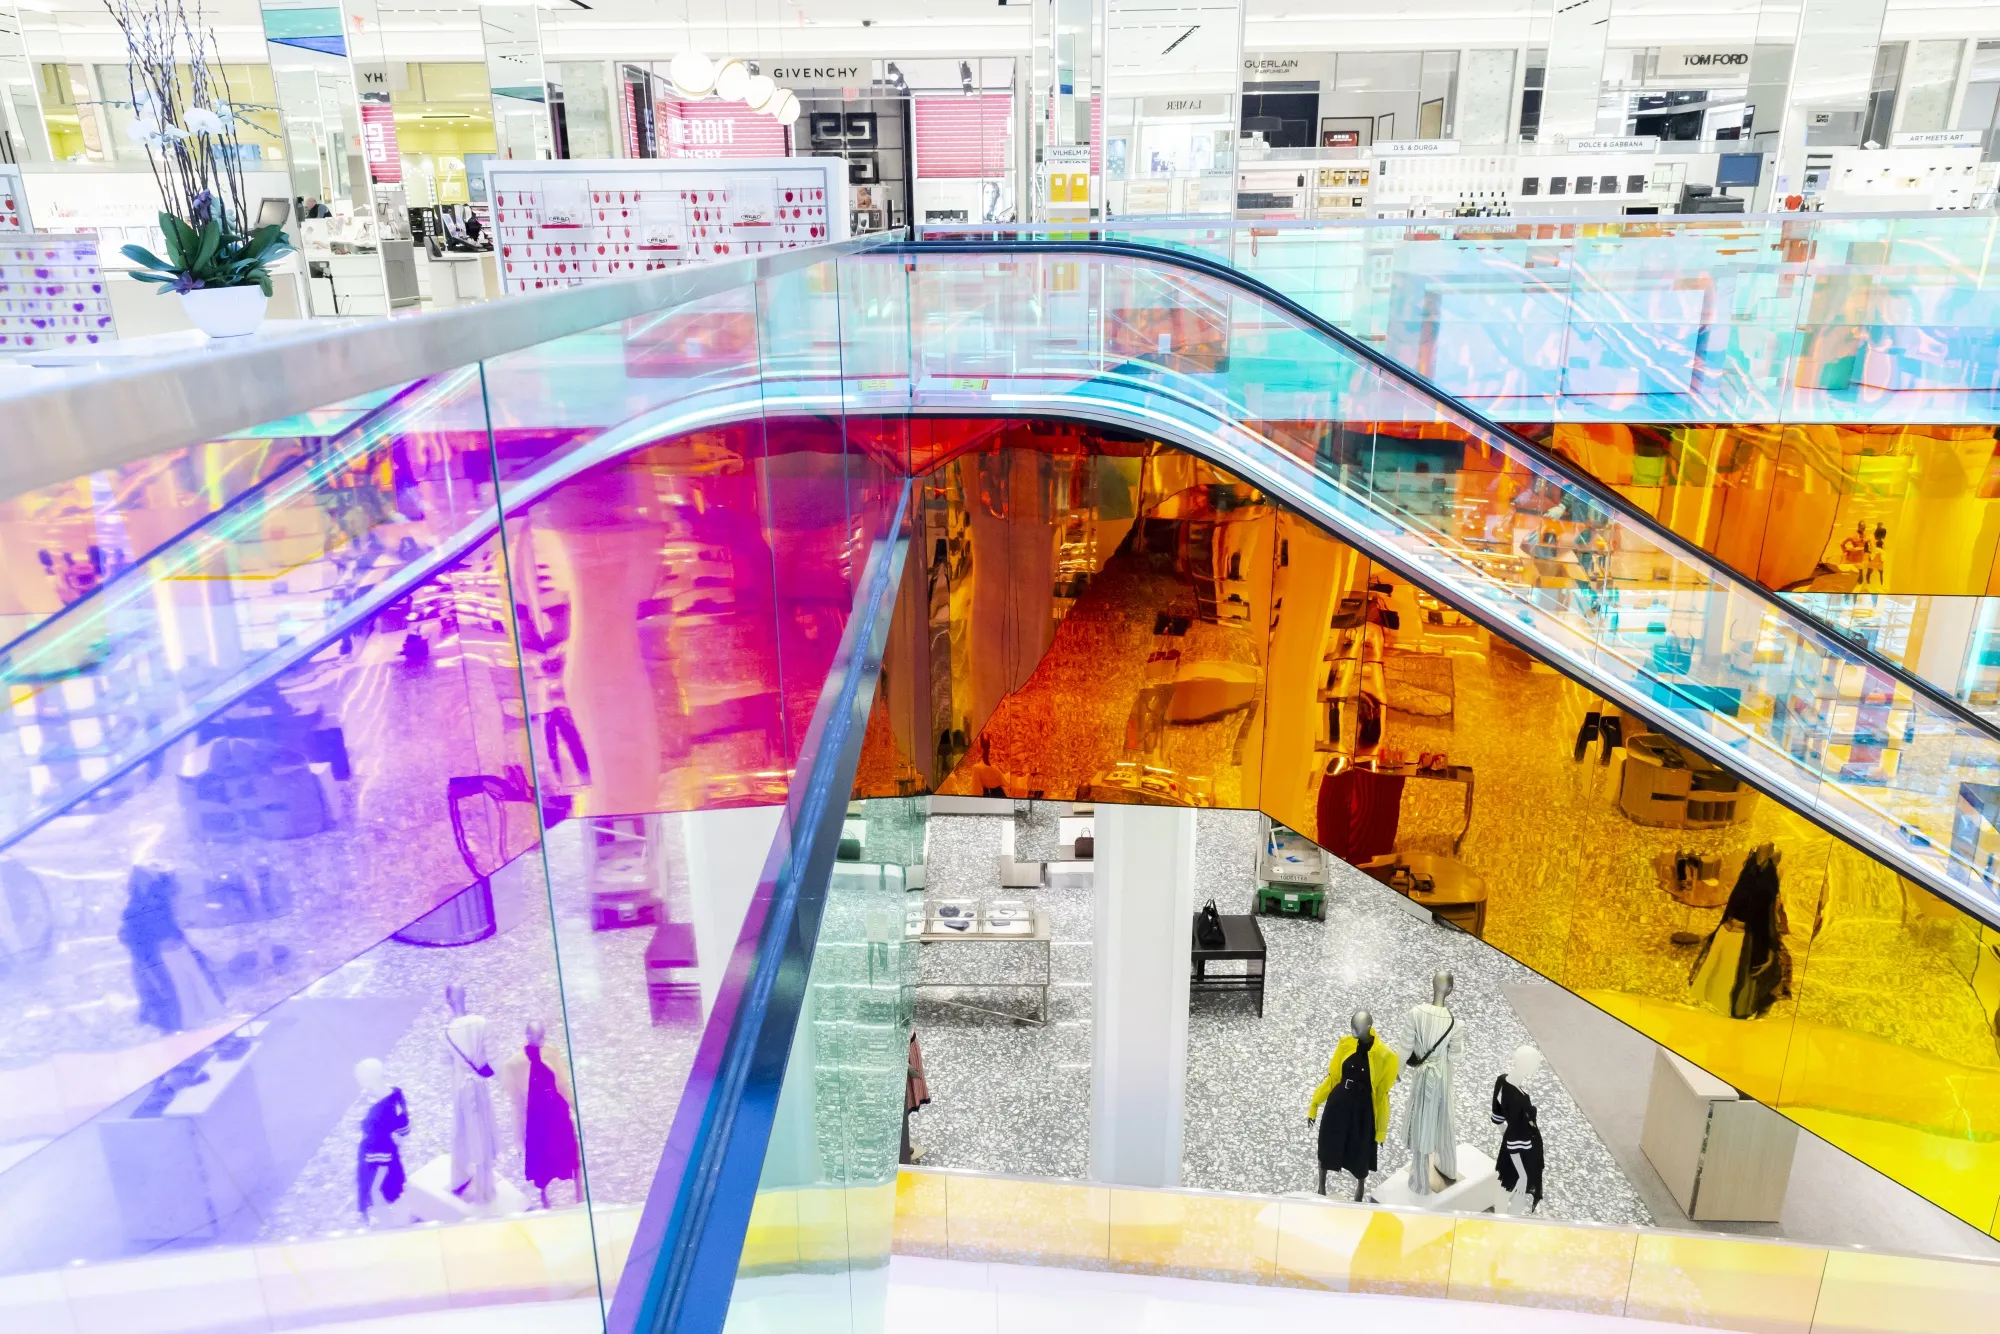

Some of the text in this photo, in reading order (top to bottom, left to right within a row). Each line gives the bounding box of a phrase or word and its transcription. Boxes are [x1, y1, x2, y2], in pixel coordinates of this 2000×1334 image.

[1683, 53, 1748, 66] TOM FORD
[1244, 60, 1299, 68] GUERLAIN
[773, 67, 858, 78] GIVENCHY
[1925, 134, 1948, 142] MEETS
[1578, 141, 1601, 149] DOLCE
